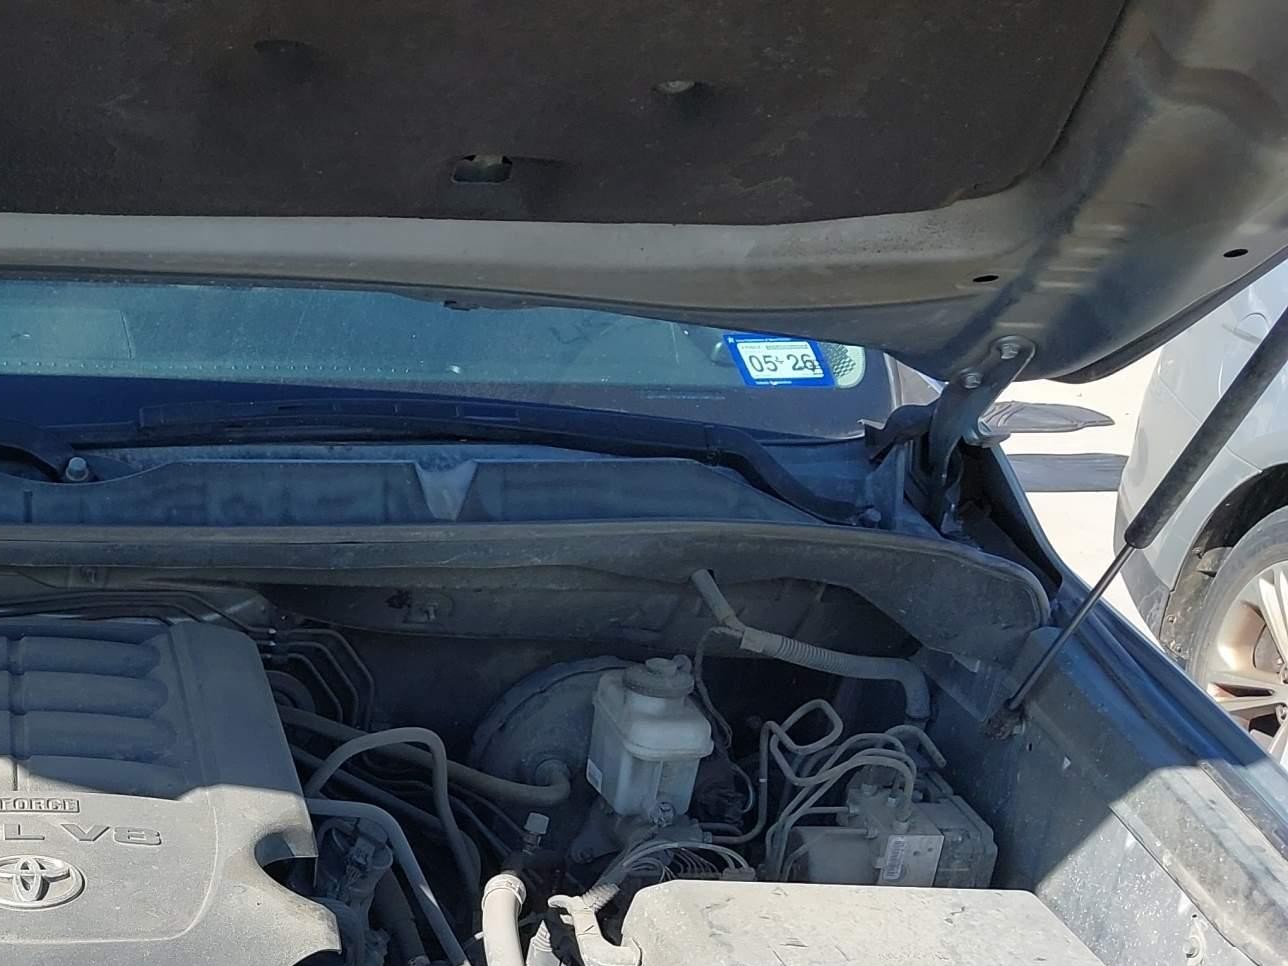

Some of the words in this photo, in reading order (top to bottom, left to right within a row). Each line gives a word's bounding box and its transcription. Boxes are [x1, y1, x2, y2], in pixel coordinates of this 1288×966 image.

[748, 354, 778, 372] 05
[786, 353, 816, 373] 26
[60, 823, 162, 845] V8
